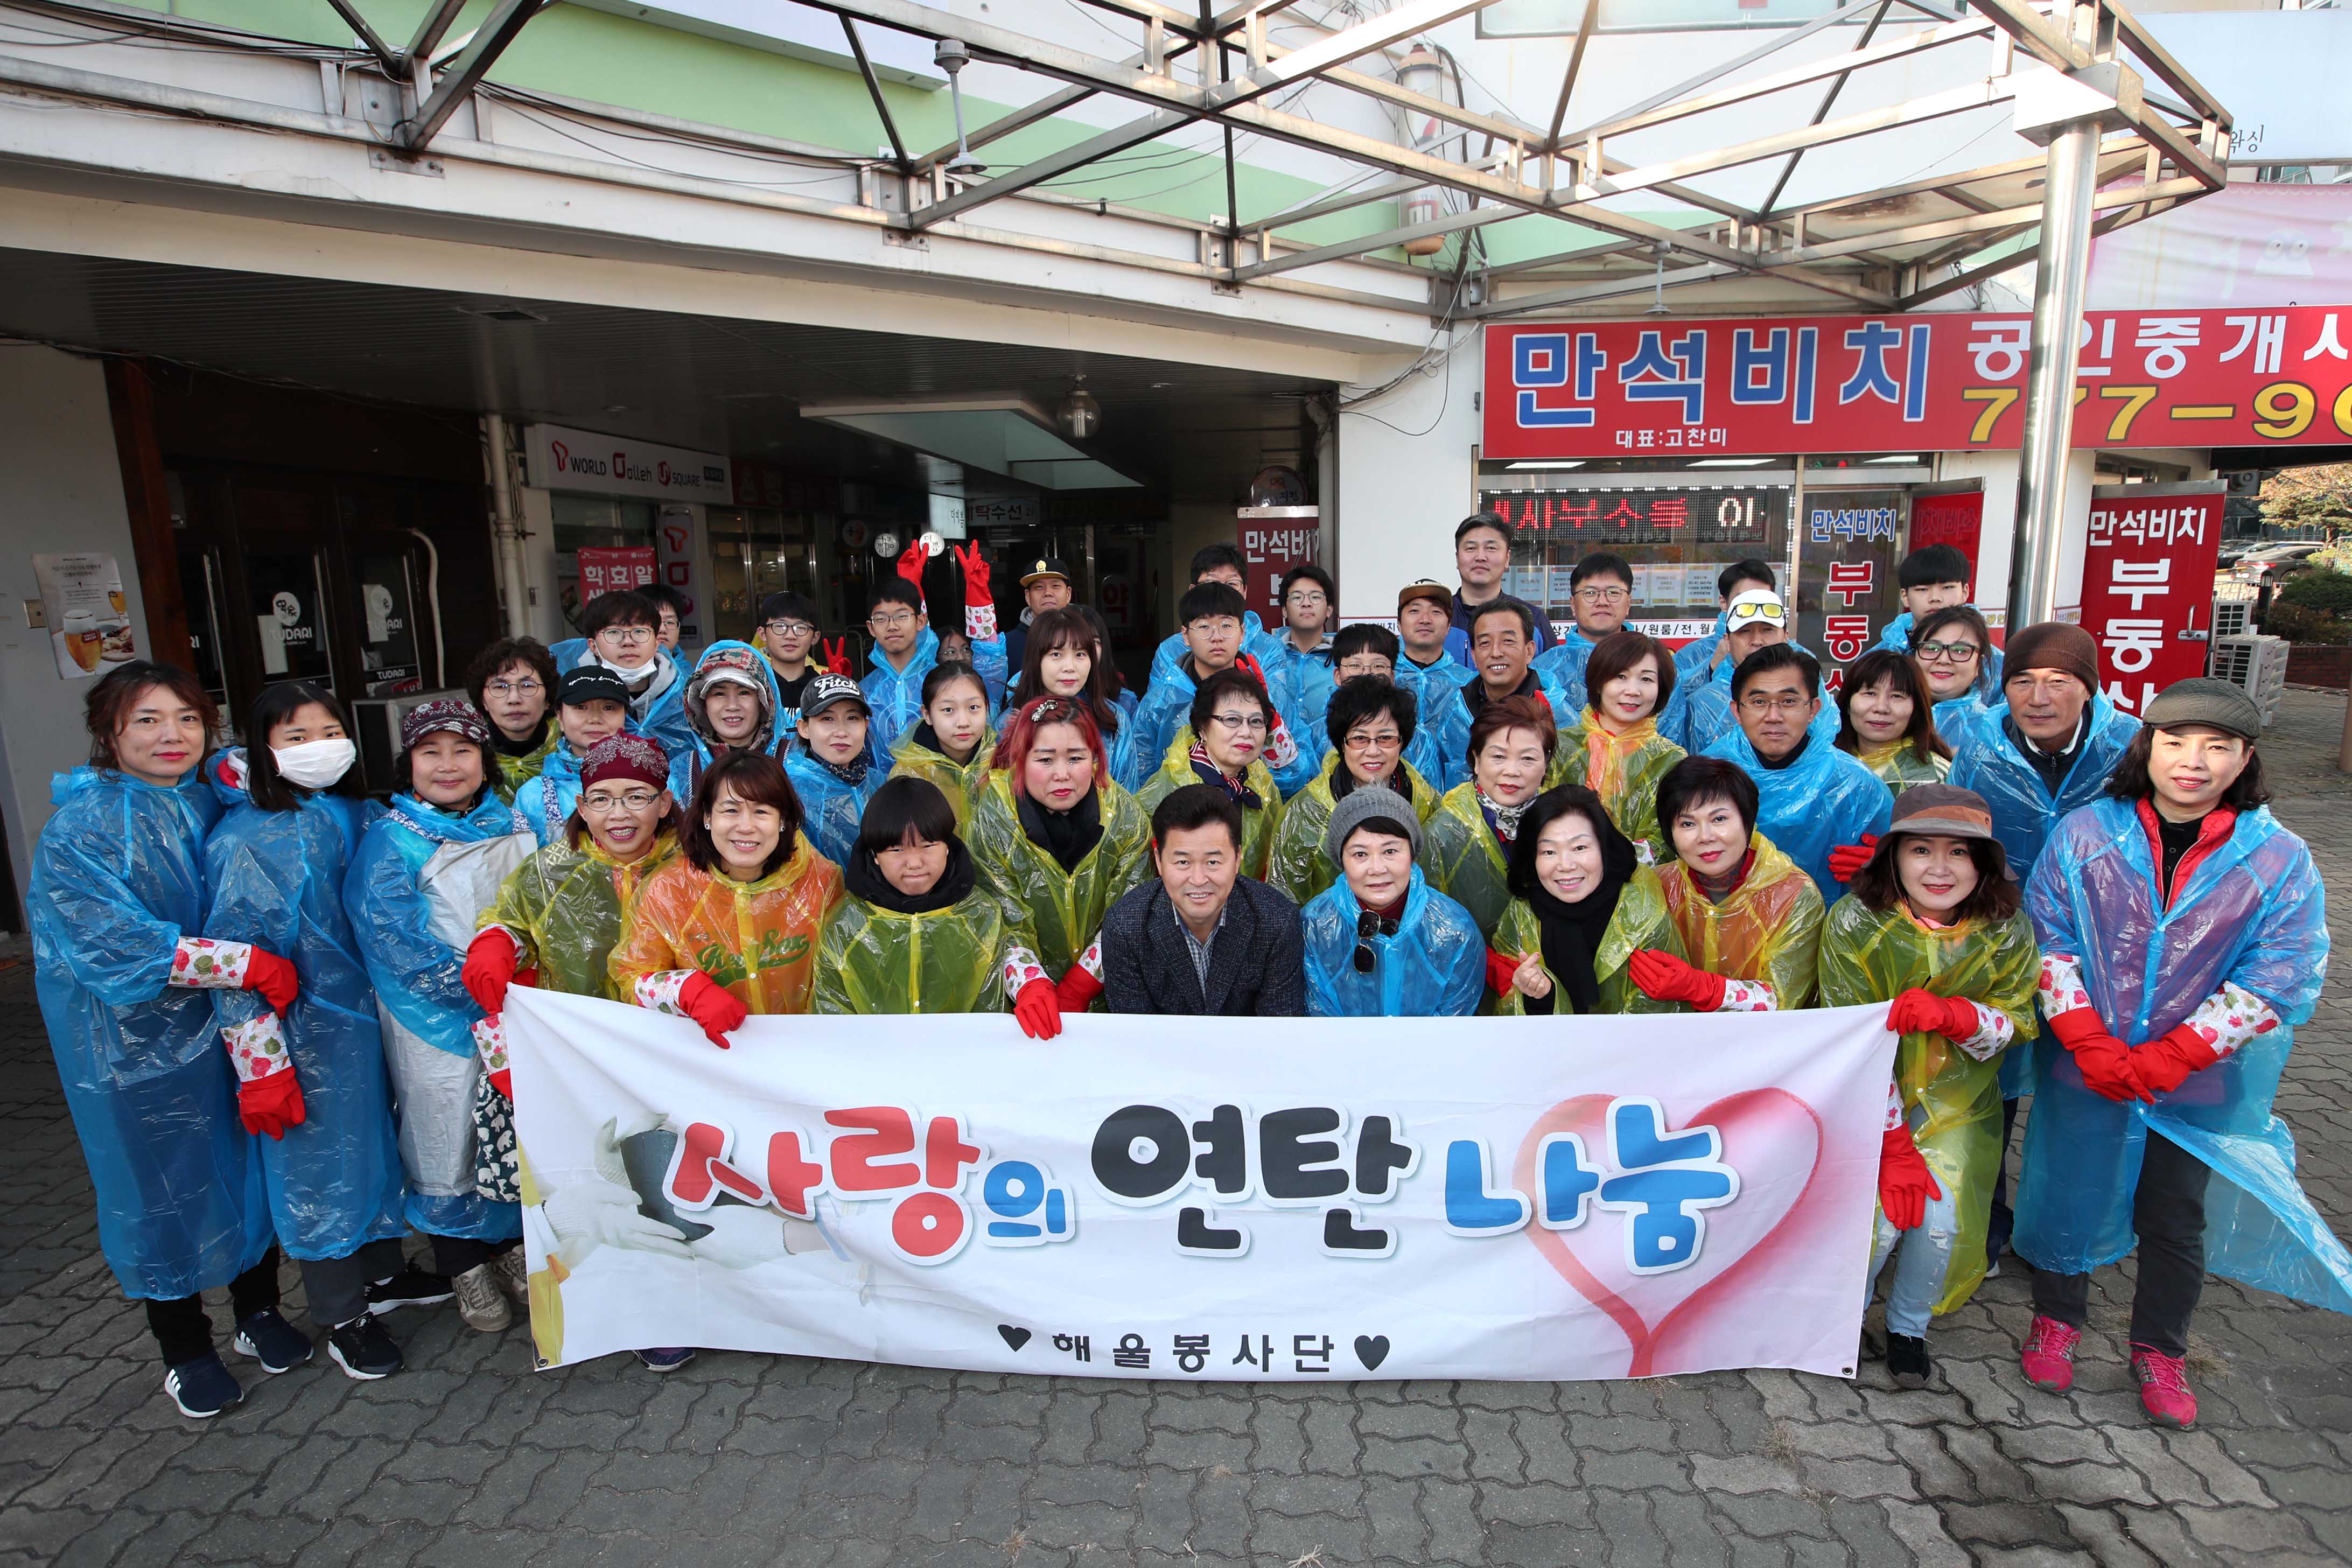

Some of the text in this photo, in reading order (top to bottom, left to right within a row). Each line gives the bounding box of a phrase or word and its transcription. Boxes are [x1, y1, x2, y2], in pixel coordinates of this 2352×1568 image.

[1511, 321, 1932, 429] 만석비치
[1616, 428, 1727, 449] 대표:고찬미
[571, 457, 607, 475] WORLD
[627, 465, 652, 481] olleh
[673, 472, 701, 487] SQUARE
[1811, 508, 1897, 542] 만석비치
[2089, 506, 2207, 546] 만석비치
[269, 626, 313, 642] TUDARI
[1635, 623, 1716, 636] /원룸/전,월
[376, 669, 405, 680] TUDARI
[814, 676, 860, 695] Fitch
[697, 943, 750, 972] Re
[668, 1101, 1734, 1271] 사랑의 연탄 나눔
